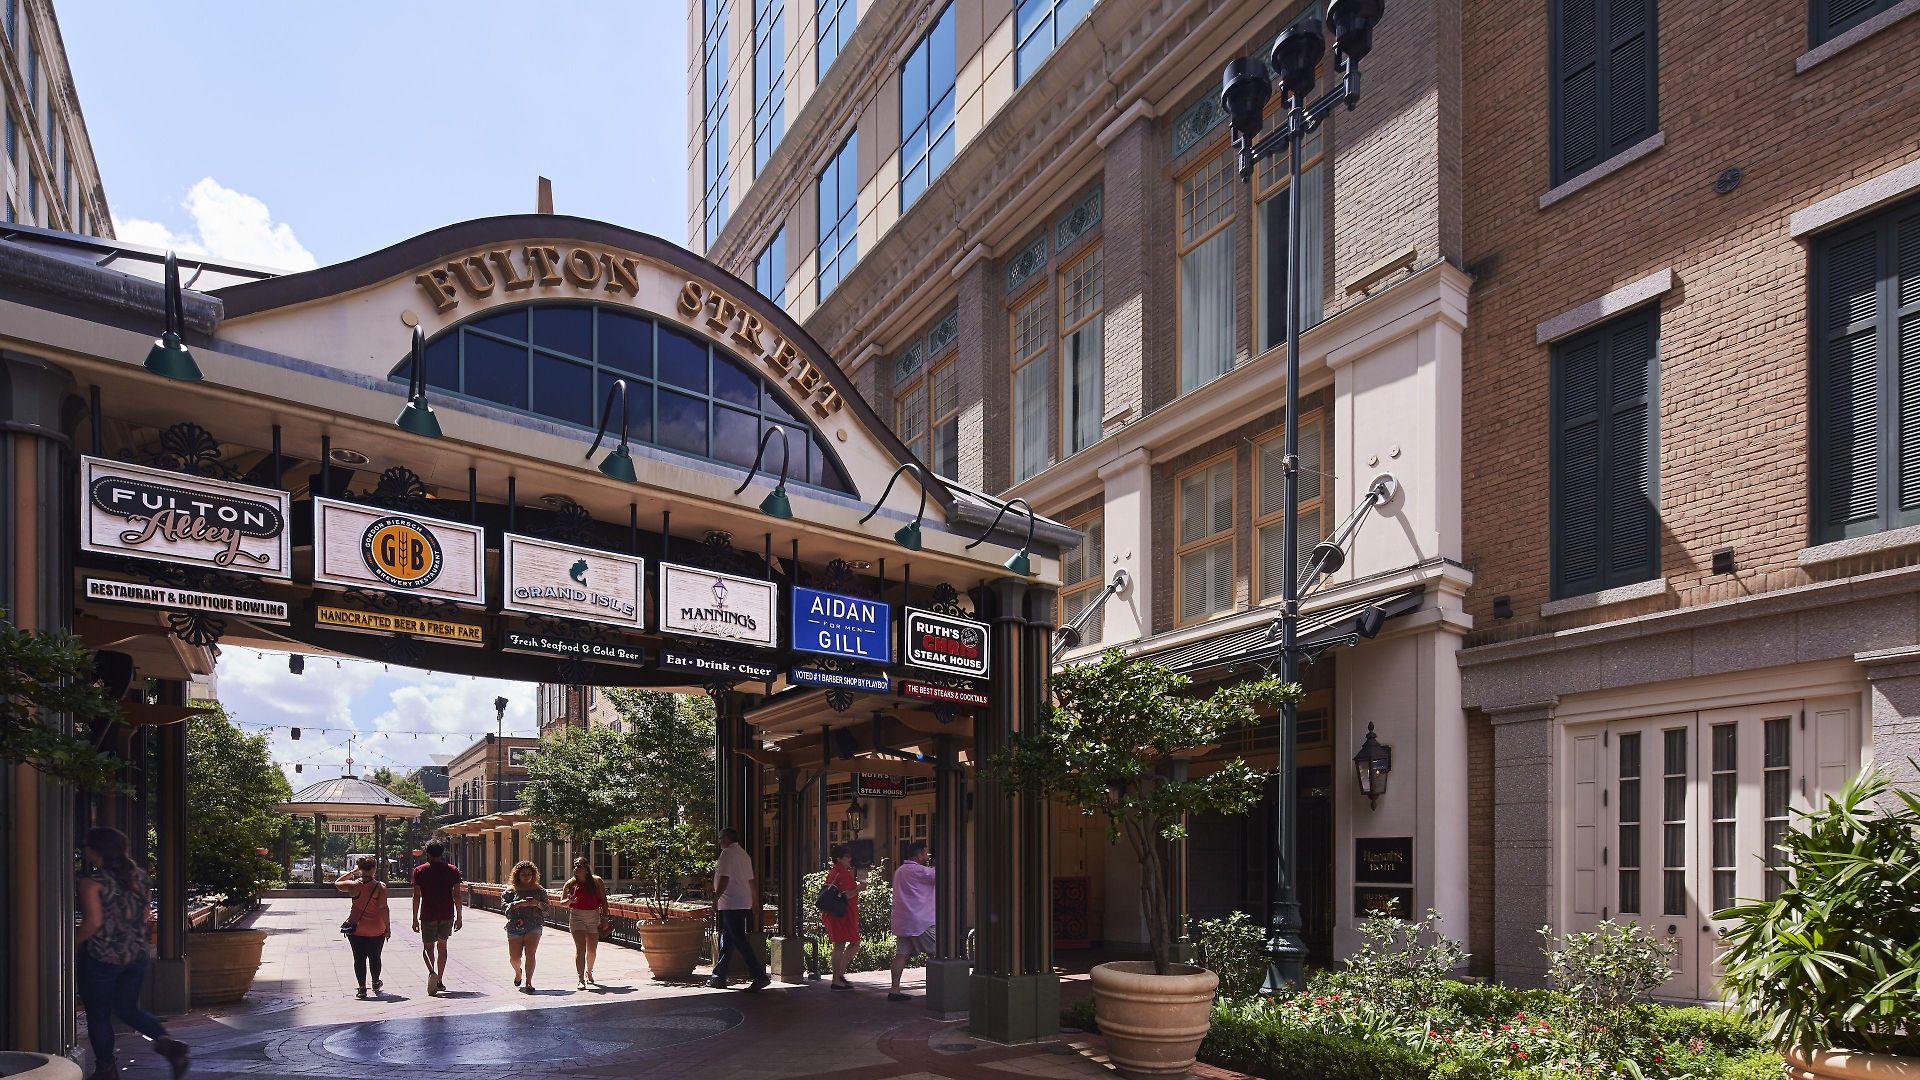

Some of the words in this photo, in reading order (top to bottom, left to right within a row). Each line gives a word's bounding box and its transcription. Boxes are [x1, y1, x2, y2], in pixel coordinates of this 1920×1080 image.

[415, 246, 640, 313] FULTON
[677, 280, 846, 419] STREET
[112, 487, 264, 528] FULTON
[120, 508, 270, 566] Alley
[365, 522, 385, 548] GORDON
[386, 519, 423, 533] BIERSCH
[375, 568, 413, 587] BREWERY
[415, 550, 441, 586] RESTAURANT
[91, 582, 166, 602] RESTAURANT
[168, 592, 177, 603] &
[179, 593, 233, 610] BOUTIQUE
[236, 600, 285, 616] BOWLING
[514, 586, 587, 602] GRAND
[591, 592, 635, 616] ISLE
[811, 596, 875, 624] AIDAN
[321, 609, 392, 627] HANDCRAFTED
[395, 618, 417, 631] BEER
[419, 622, 426, 631] &
[428, 622, 455, 635] FRESH
[458, 626, 480, 638] FARE
[823, 621, 841, 630] FOR
[916, 621, 960, 640] RUTH'S
[510, 634, 539, 647] Fresh
[541, 638, 580, 653] Seafood
[582, 644, 590, 653] &
[593, 645, 616, 657] Cold
[618, 649, 639, 660] Beer
[819, 630, 868, 655] GILL
[922, 634, 978, 660] CHRIS
[667, 654, 687, 666] Eat
[696, 658, 731, 671] Drink
[739, 664, 772, 676] Cheer
[914, 649, 947, 663] STEAK
[950, 656, 982, 669] HOUSE
[795, 670, 813, 680] VOTED
[822, 674, 843, 683] BARBER
[844, 676, 857, 685] SHOP
[858, 678, 865, 687] BY
[866, 679, 888, 690] PLAYBOY
[907, 684, 919, 693] THE
[920, 686, 933, 696] BEST
[934, 688, 954, 698] STEAKS
[959, 692, 988, 704] COCKTAILS
[331, 824, 350, 832] FULTON
[351, 824, 371, 832] STREET
